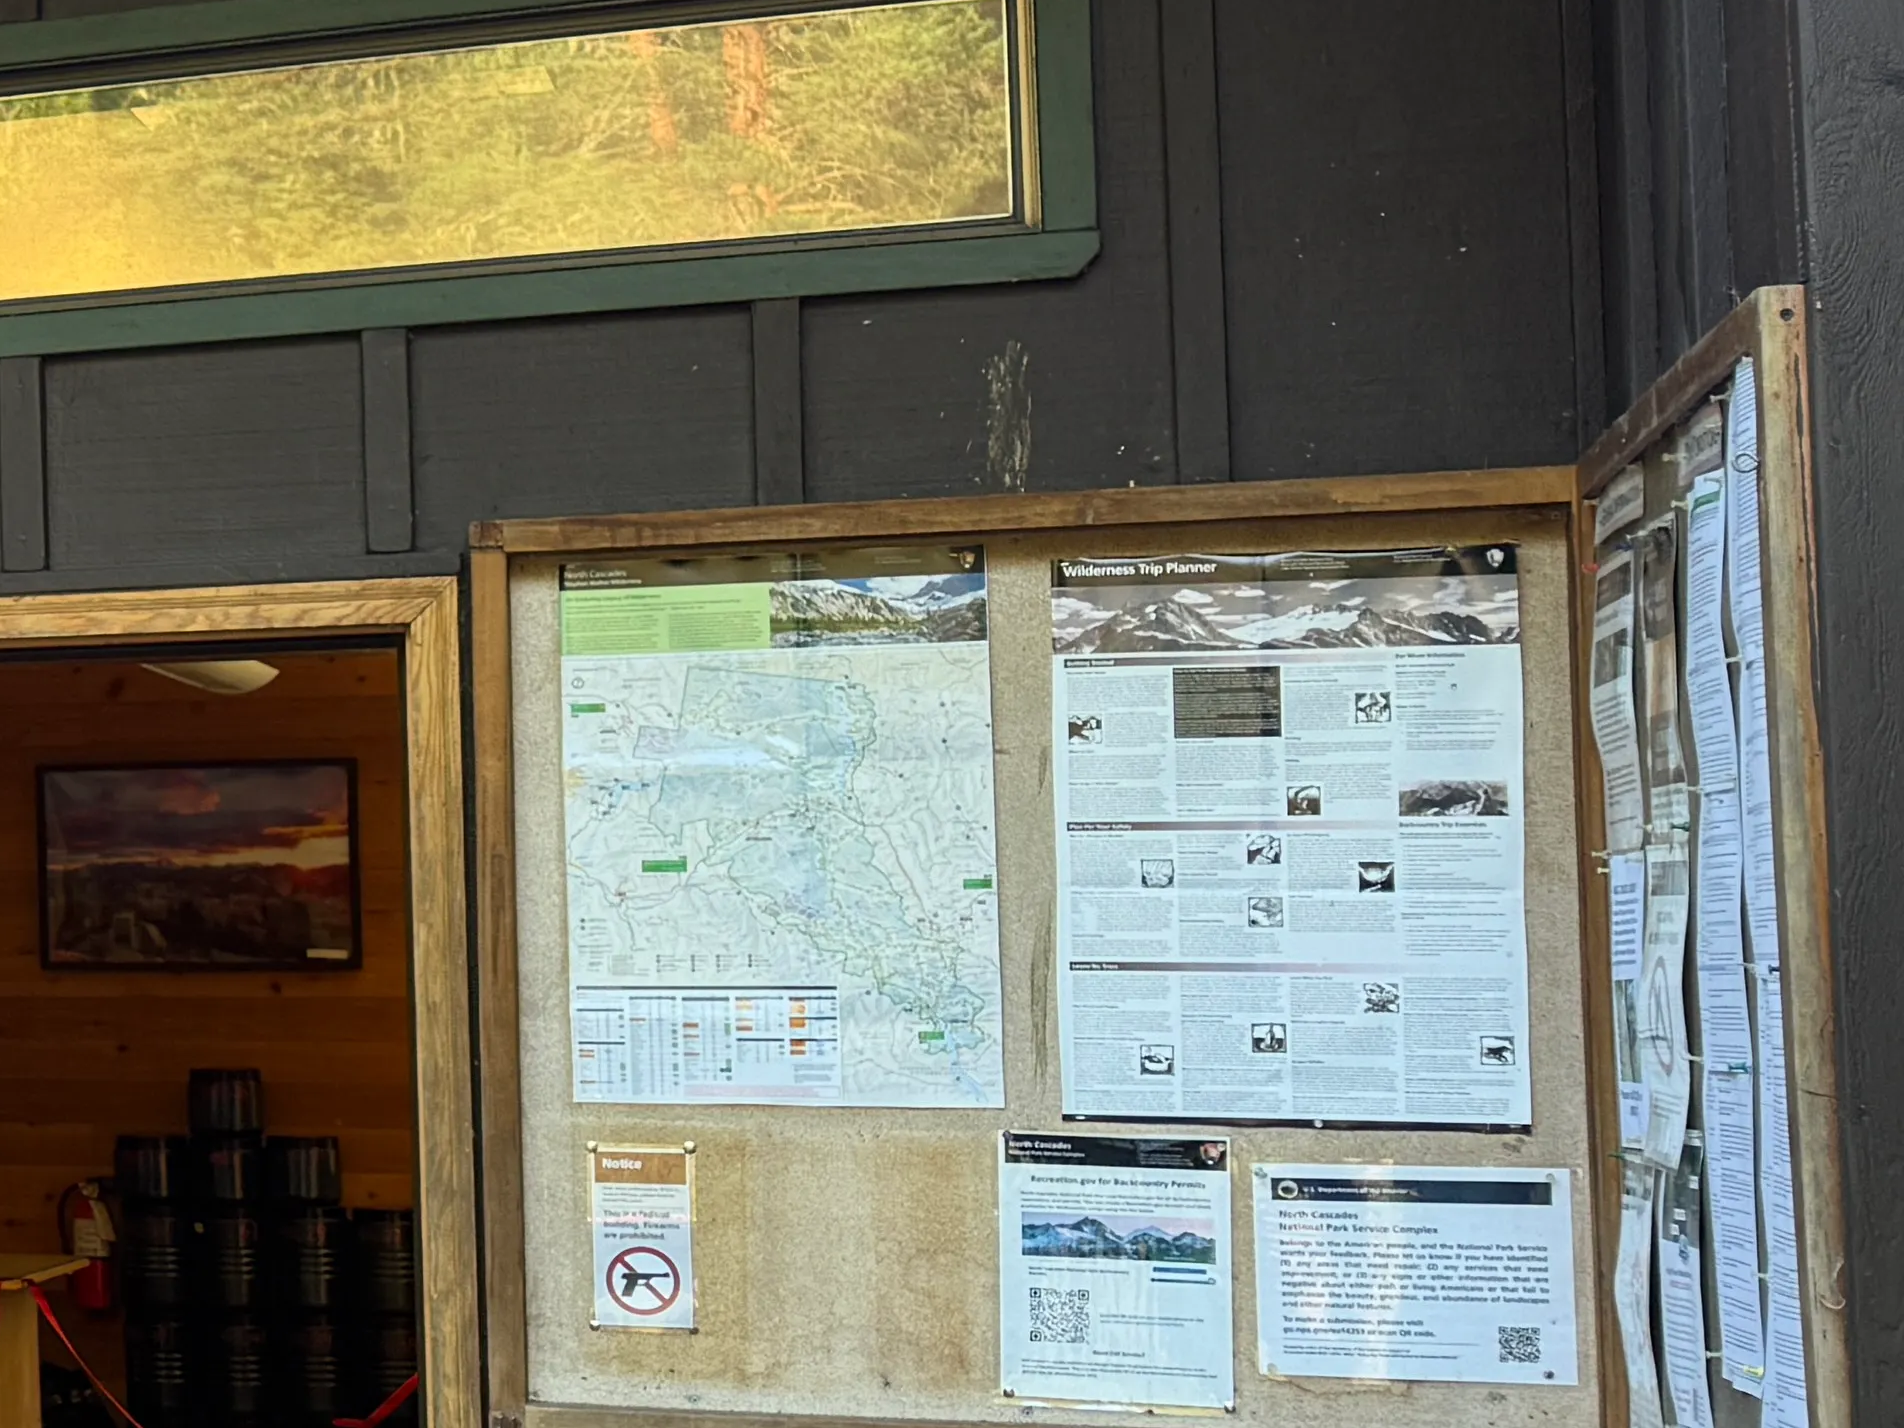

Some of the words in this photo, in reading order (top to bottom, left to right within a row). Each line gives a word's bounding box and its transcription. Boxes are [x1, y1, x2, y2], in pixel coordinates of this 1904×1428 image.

[1062, 563, 1136, 578] Wilderness
[1138, 562, 1164, 578] Trip
[1166, 561, 1218, 574] Planner
[602, 1157, 642, 1170] Notice
[1031, 1175, 1096, 1186] Recreation.gov
[1098, 1177, 1112, 1185] for
[1113, 1178, 1169, 1189] Backcountry
[1171, 1180, 1206, 1189] Permits
[1278, 1210, 1308, 1219] North
[1310, 1211, 1359, 1220] Cascades
[1278, 1222, 1324, 1231] National
[1326, 1223, 1349, 1232] Park
[1351, 1223, 1390, 1232] Service
[1392, 1225, 1439, 1235] Complex
